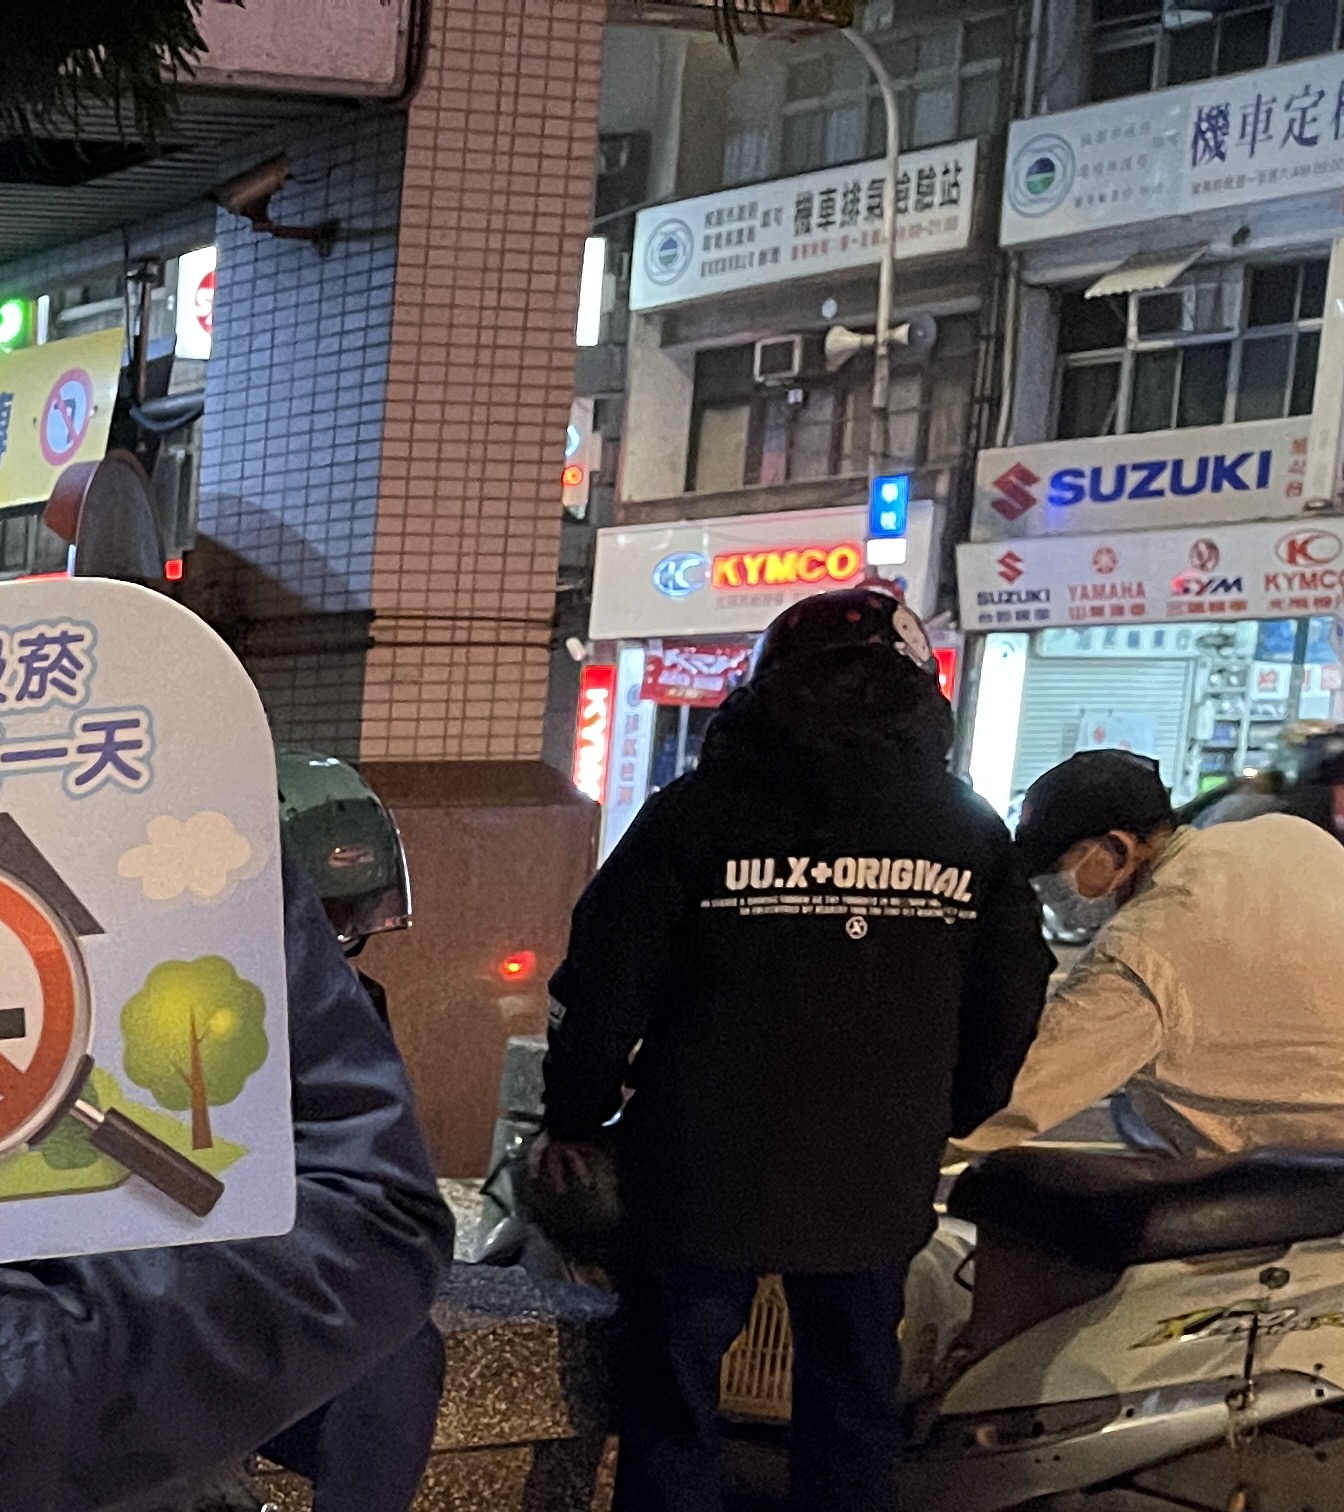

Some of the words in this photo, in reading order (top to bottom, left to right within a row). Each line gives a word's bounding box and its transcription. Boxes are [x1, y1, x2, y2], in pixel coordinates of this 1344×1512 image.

[1047, 450, 1273, 507] SUZUKI
[714, 544, 859, 587] KYMCO
[977, 588, 1050, 606] SUZUKI
[1068, 581, 1146, 601] YAMAHA
